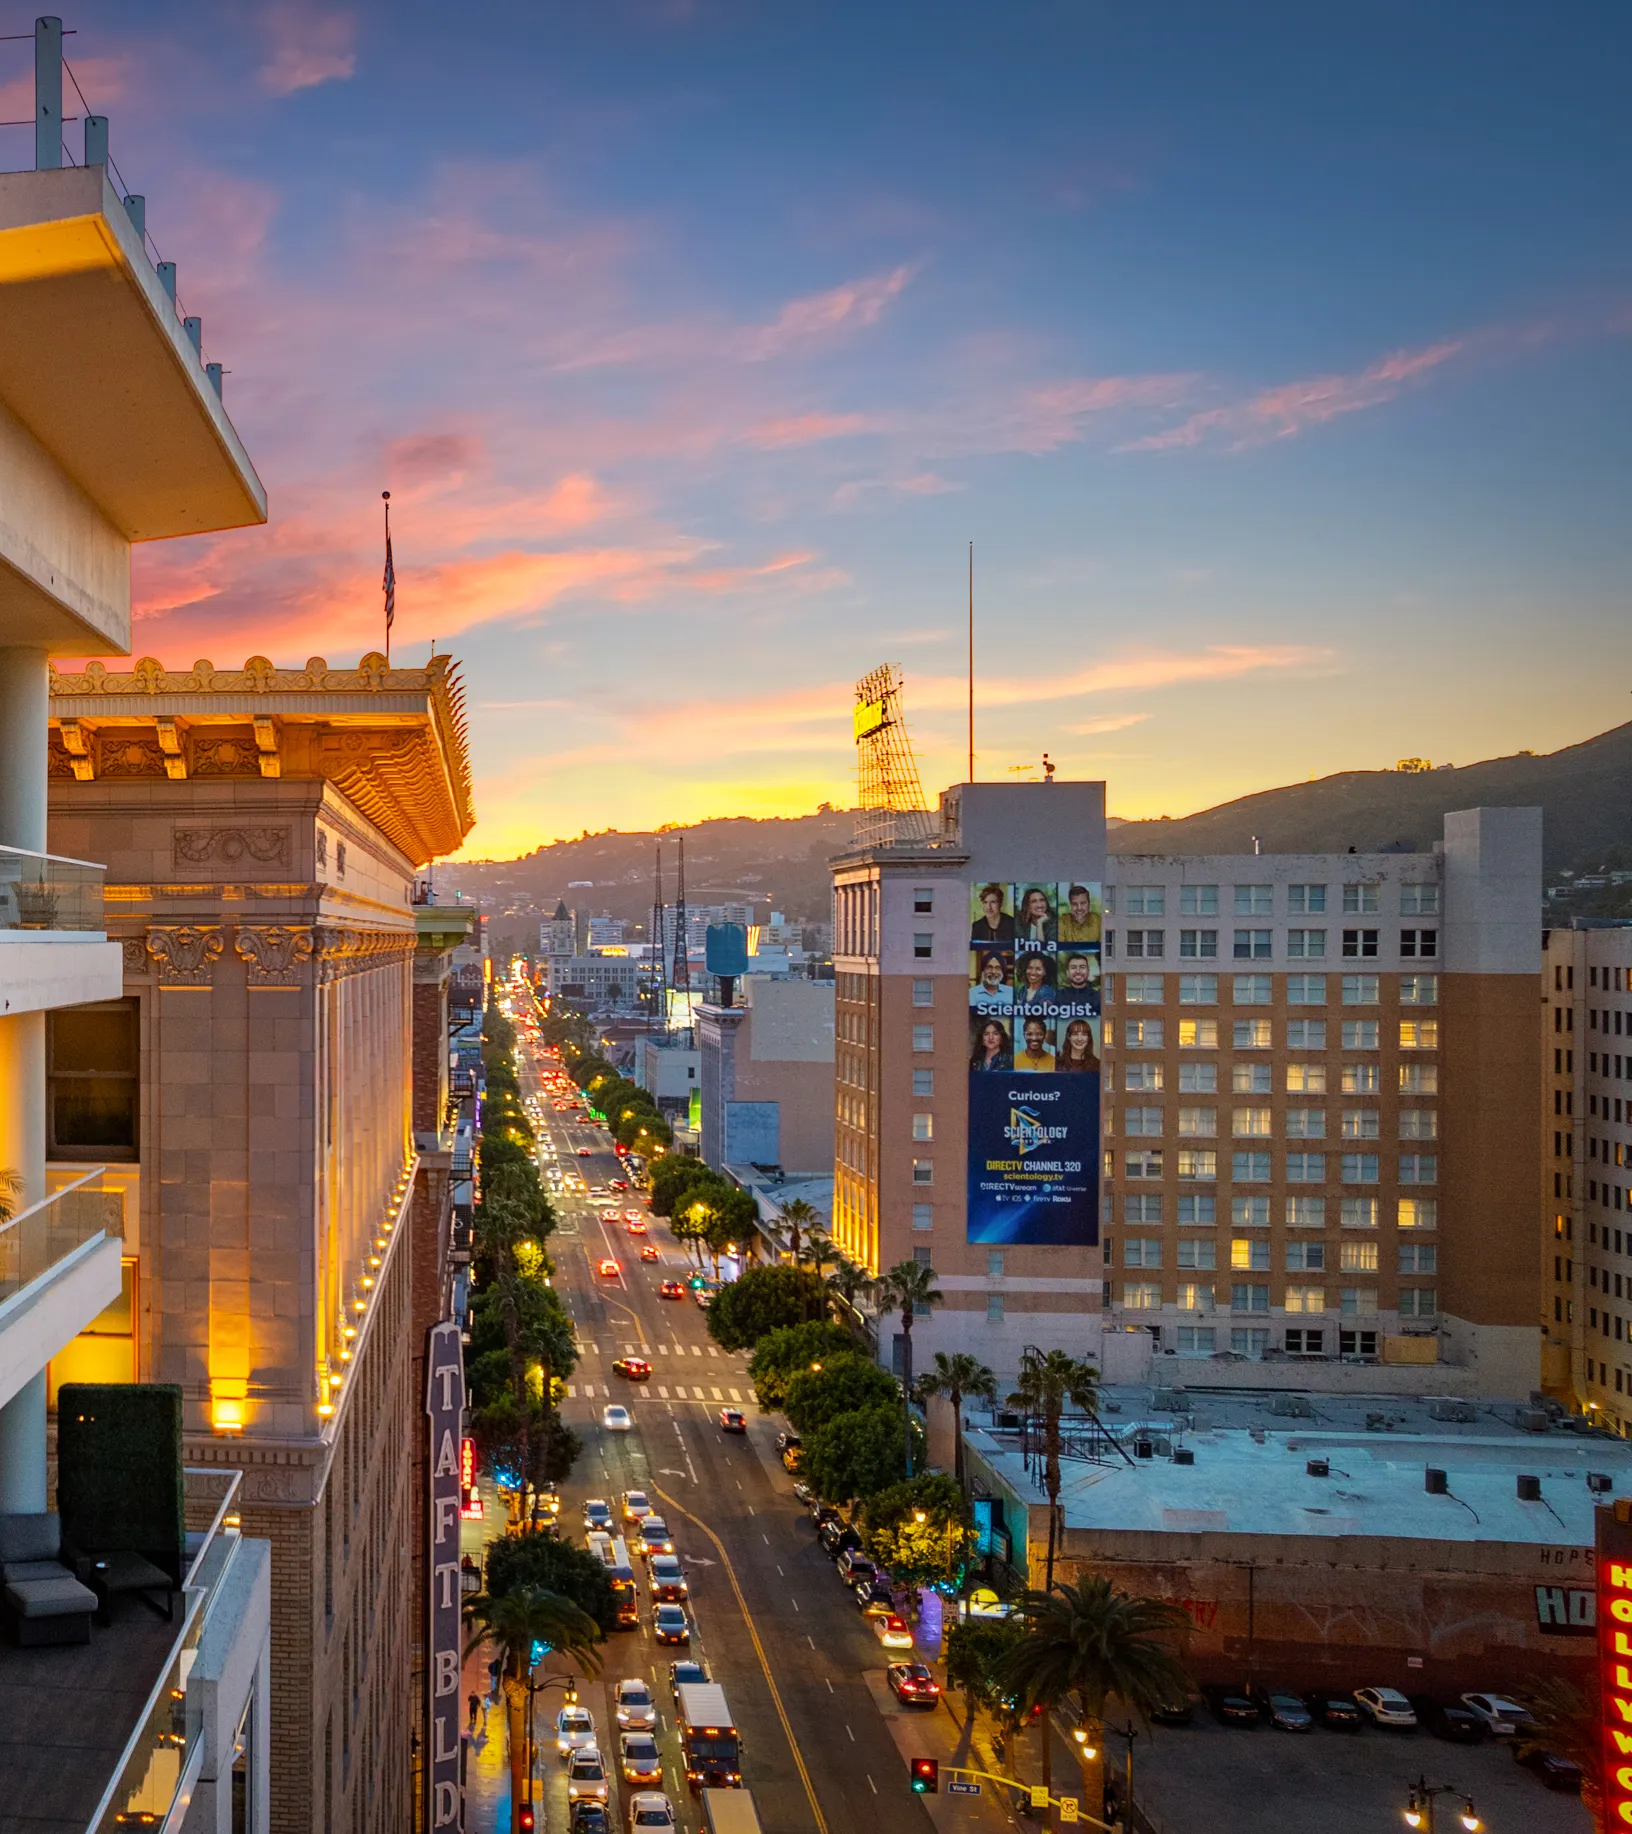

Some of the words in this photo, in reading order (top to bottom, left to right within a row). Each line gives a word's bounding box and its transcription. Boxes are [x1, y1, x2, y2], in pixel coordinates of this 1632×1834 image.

[1014, 938, 1041, 952] I'm
[1047, 940, 1057, 952] a
[977, 1002, 1097, 1018] Scientologist.
[1008, 1090, 1061, 1101] Curious?
[1004, 1126, 1068, 1139] SCIENTOLOGY
[986, 1160, 1022, 1171] DIRECTV
[1023, 1161, 1063, 1172] CHANNEL
[1064, 1161, 1081, 1172] 320
[1003, 1172, 1064, 1181] scientology.tv
[462, 1440, 473, 1490] IGUANA
[434, 1364, 459, 1608] TAFT
[1540, 1548, 1595, 1567] HOPE
[435, 1649, 459, 1827] BLD
[952, 1784, 967, 1792] Vine
[969, 1785, 978, 1793] St
